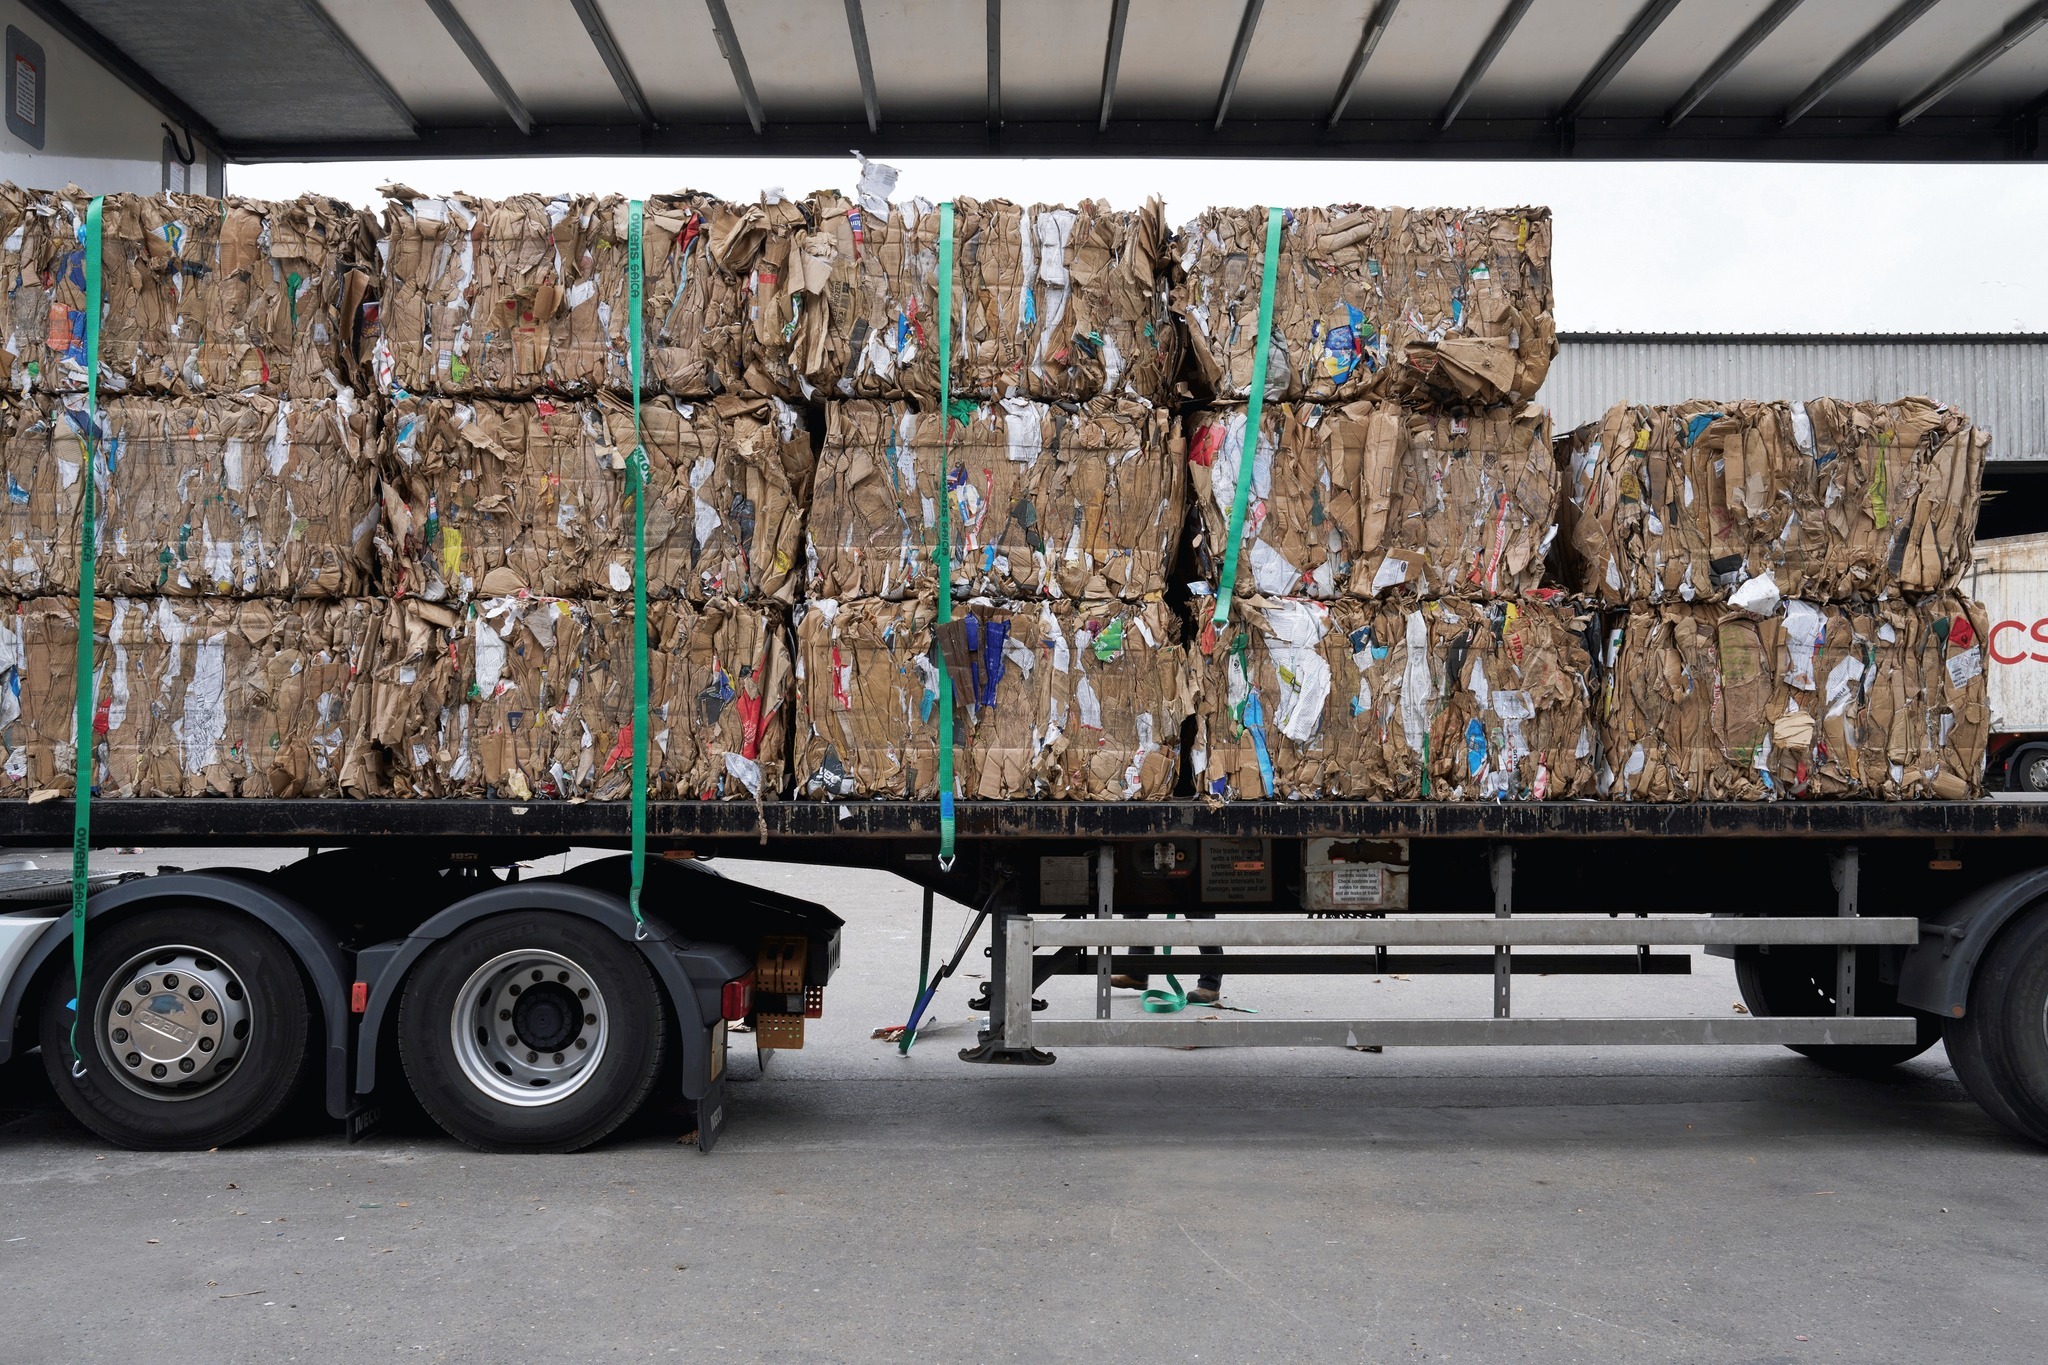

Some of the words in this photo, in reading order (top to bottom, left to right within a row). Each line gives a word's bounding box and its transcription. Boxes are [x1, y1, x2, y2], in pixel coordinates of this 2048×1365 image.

[75, 827, 87, 879] owens
[449, 851, 480, 860] JOST
[138, 1009, 193, 1044] IVECO
[354, 1106, 381, 1135] IVECO
